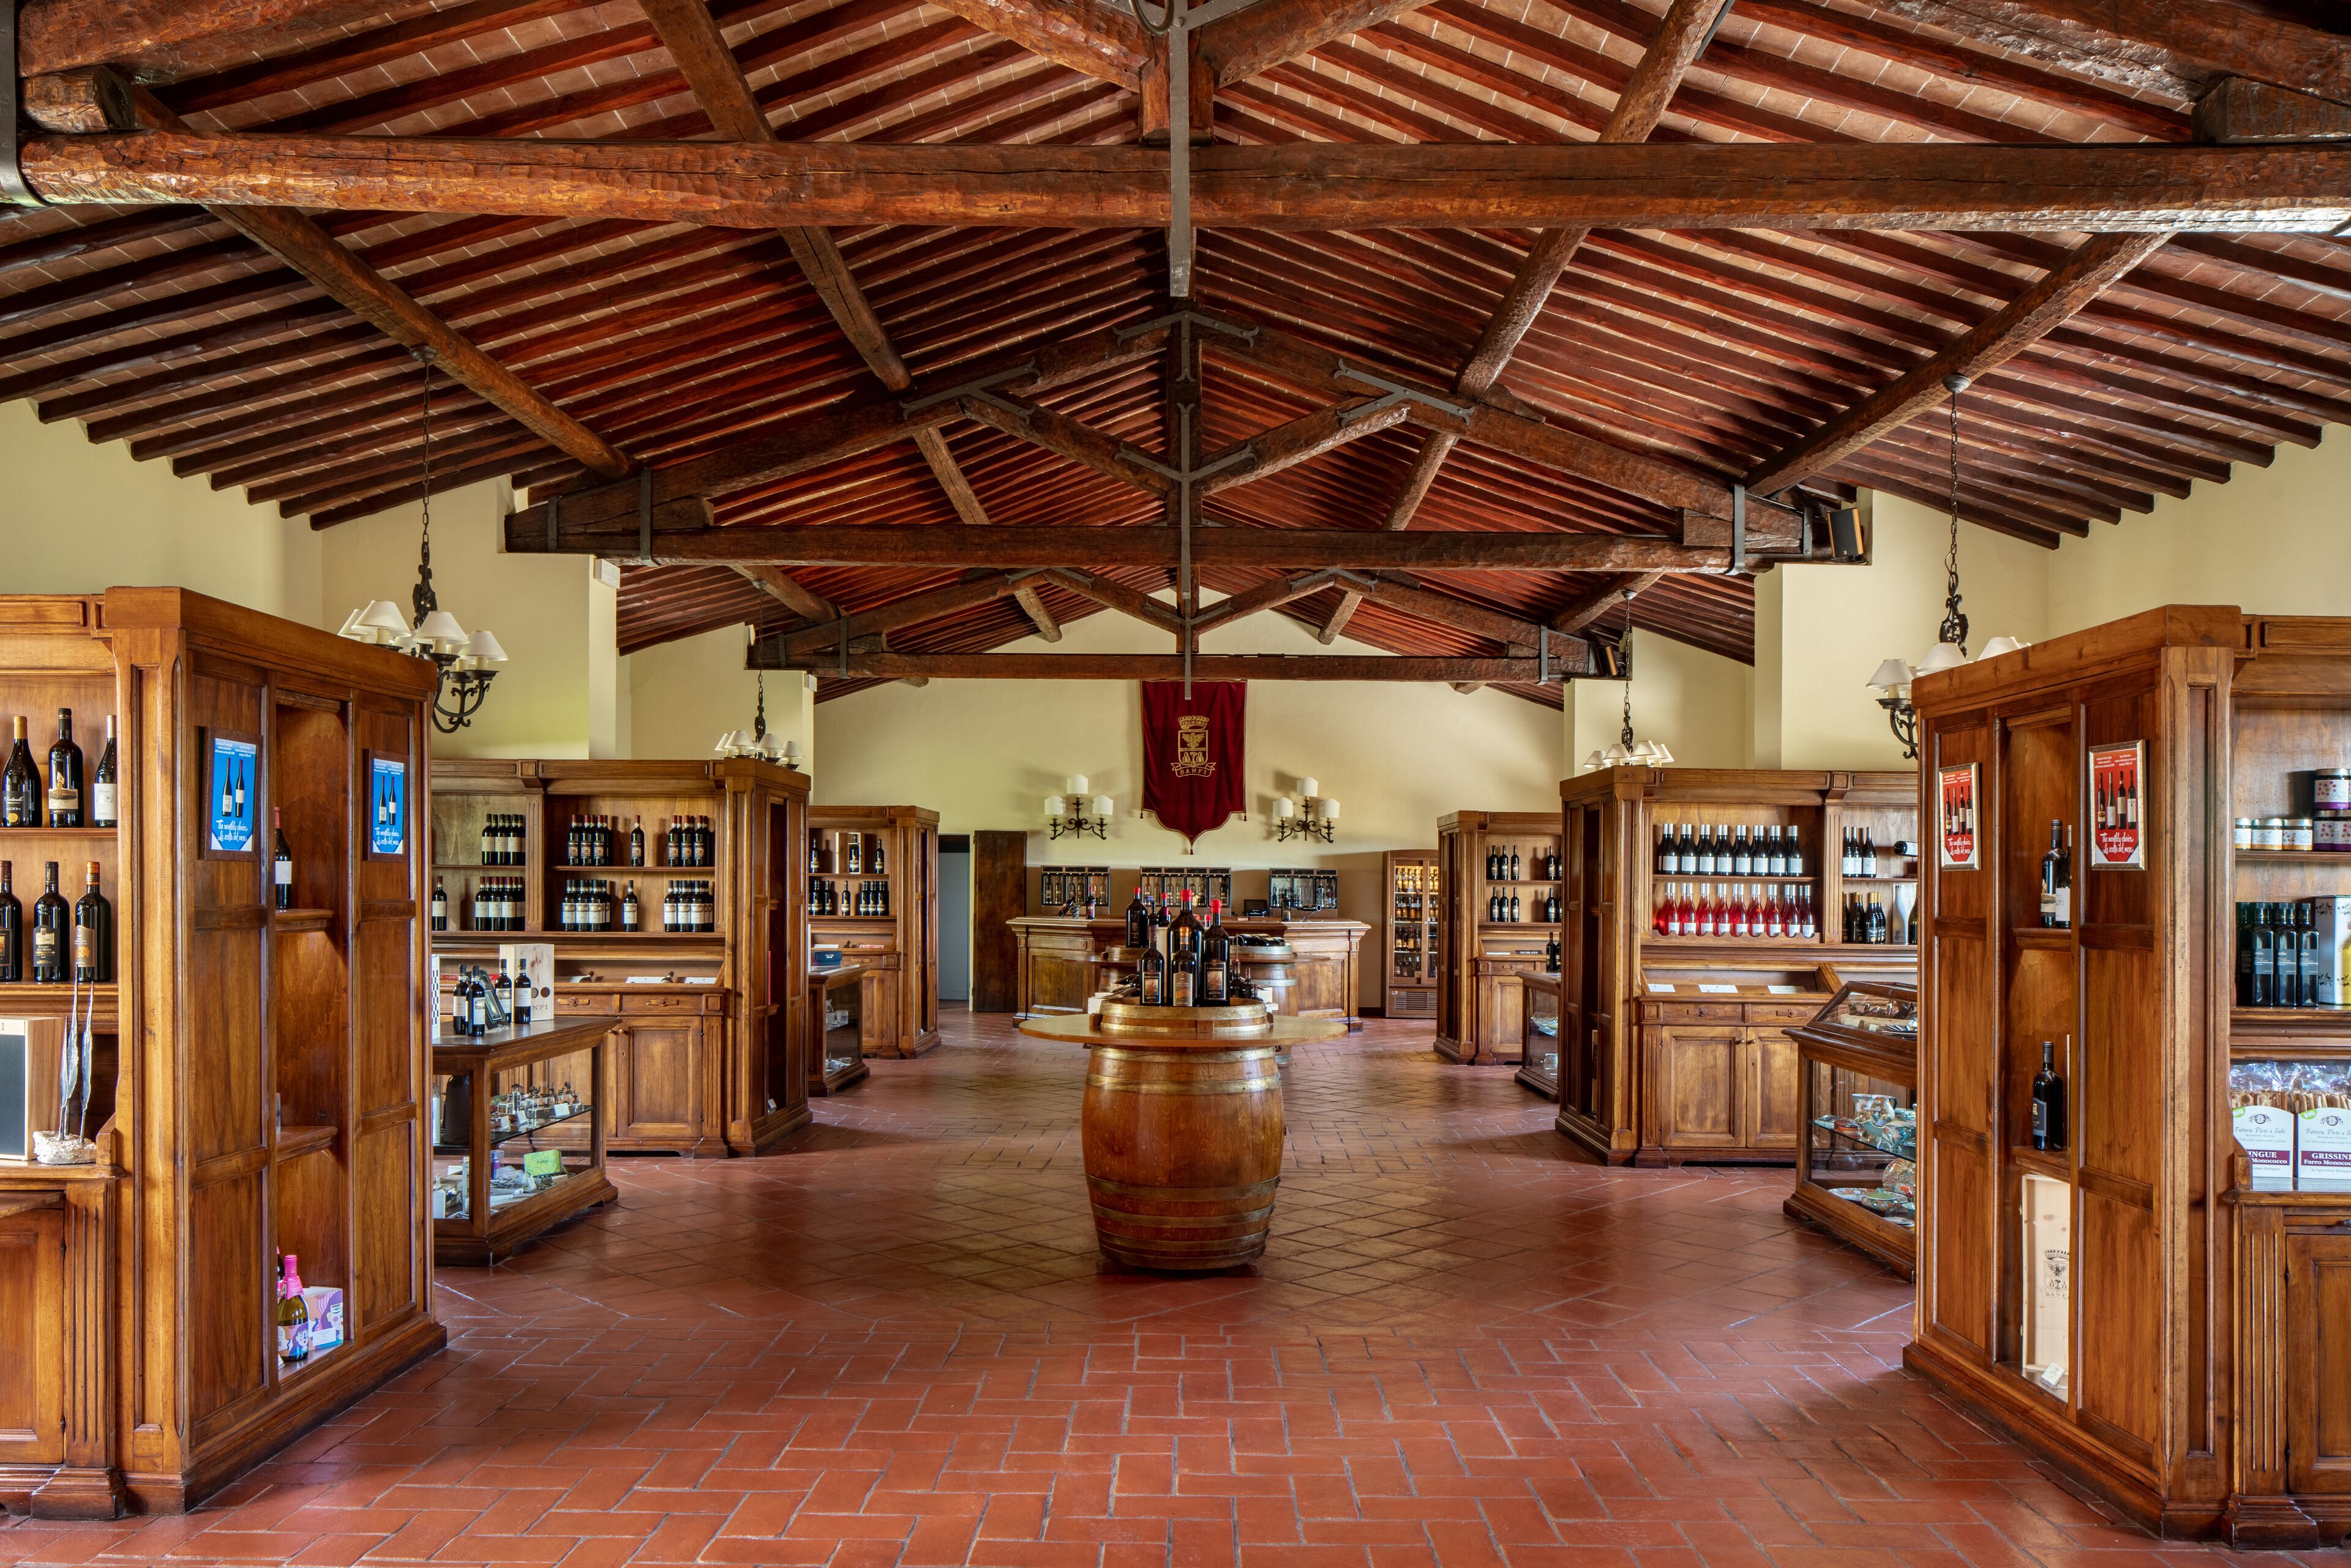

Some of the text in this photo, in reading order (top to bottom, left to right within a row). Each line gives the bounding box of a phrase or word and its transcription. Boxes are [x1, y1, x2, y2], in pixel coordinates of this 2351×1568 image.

[224, 820, 237, 834] monthly
[237, 821, 248, 831] choice
[2108, 832, 2121, 846] monthly
[2121, 831, 2134, 842] choice
[2102, 843, 2109, 854] La
[2109, 842, 2118, 853] scelta
